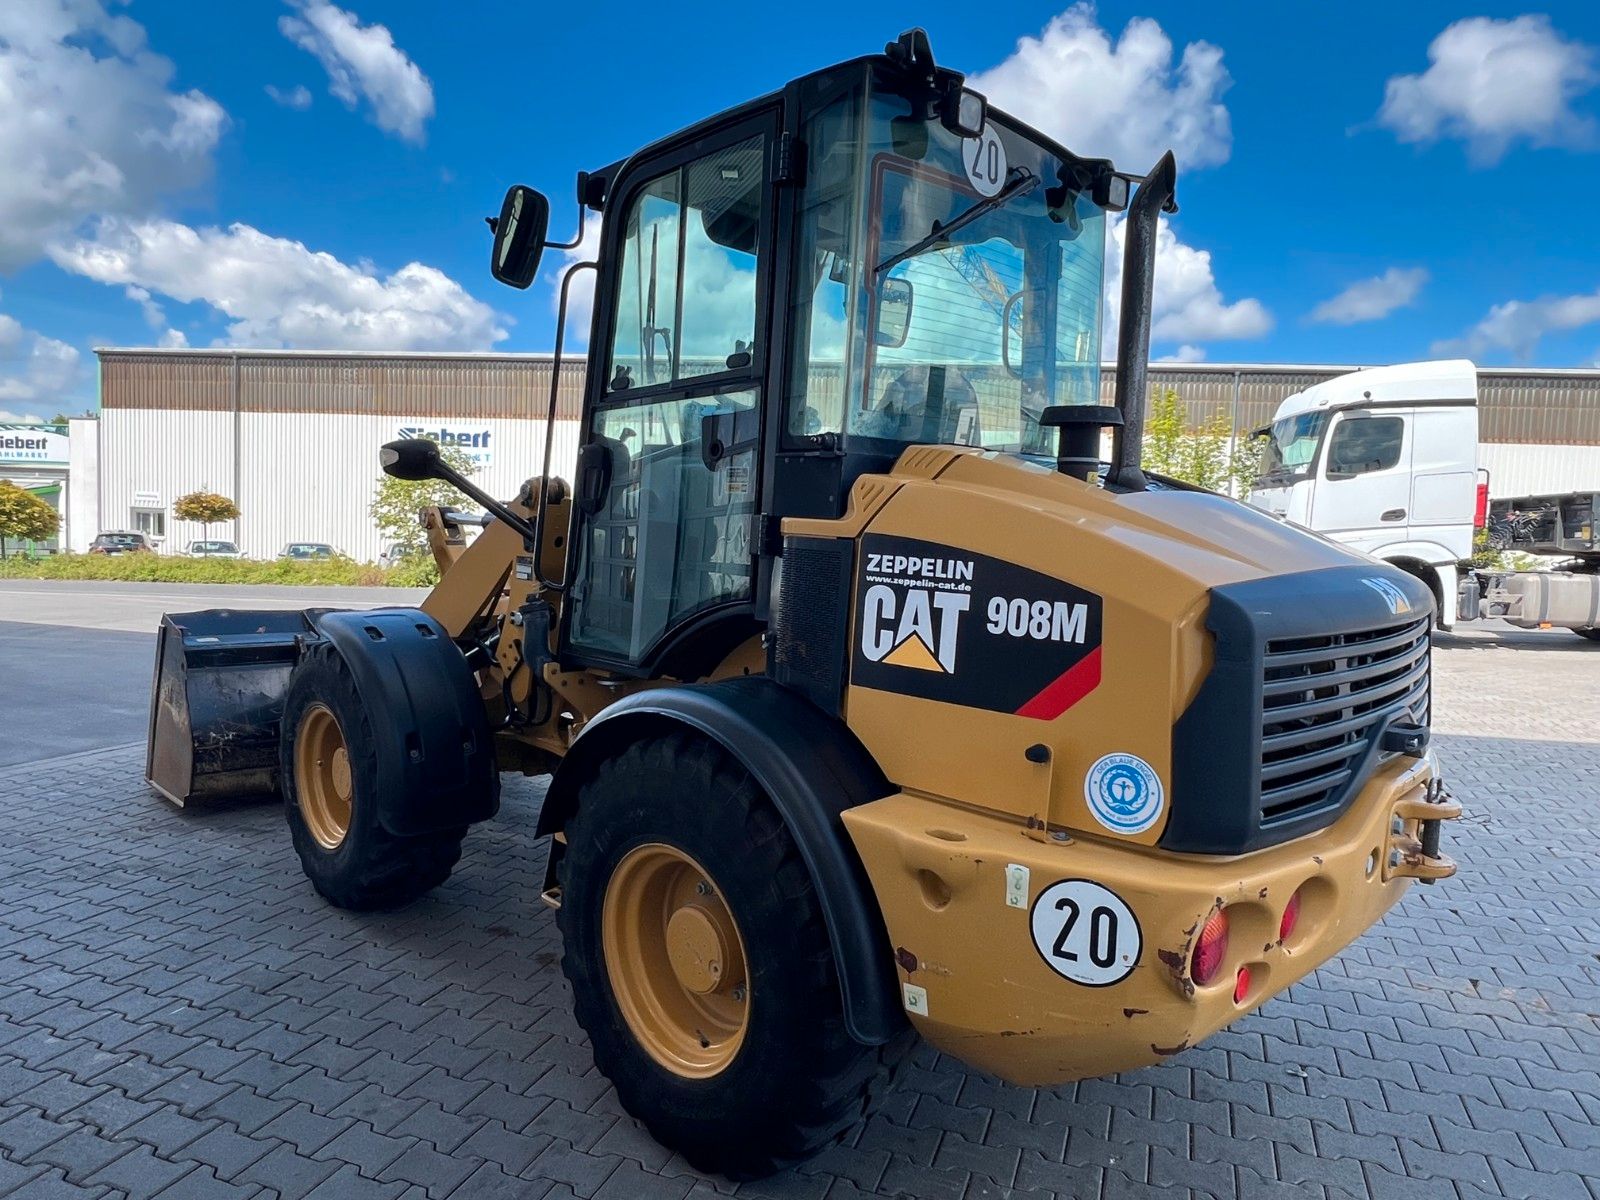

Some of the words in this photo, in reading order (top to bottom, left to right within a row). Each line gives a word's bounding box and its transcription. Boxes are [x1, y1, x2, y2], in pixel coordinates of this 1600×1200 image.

[972, 137, 998, 184] 20
[865, 574, 972, 592] www.zeppelin-cat.de
[866, 553, 975, 581] ZEPPELIN
[861, 584, 971, 675] CAT
[986, 596, 1088, 644] 908M
[1097, 761, 1110, 775] DER
[1135, 762, 1153, 783] ENGEL
[1052, 897, 1118, 969] 20
